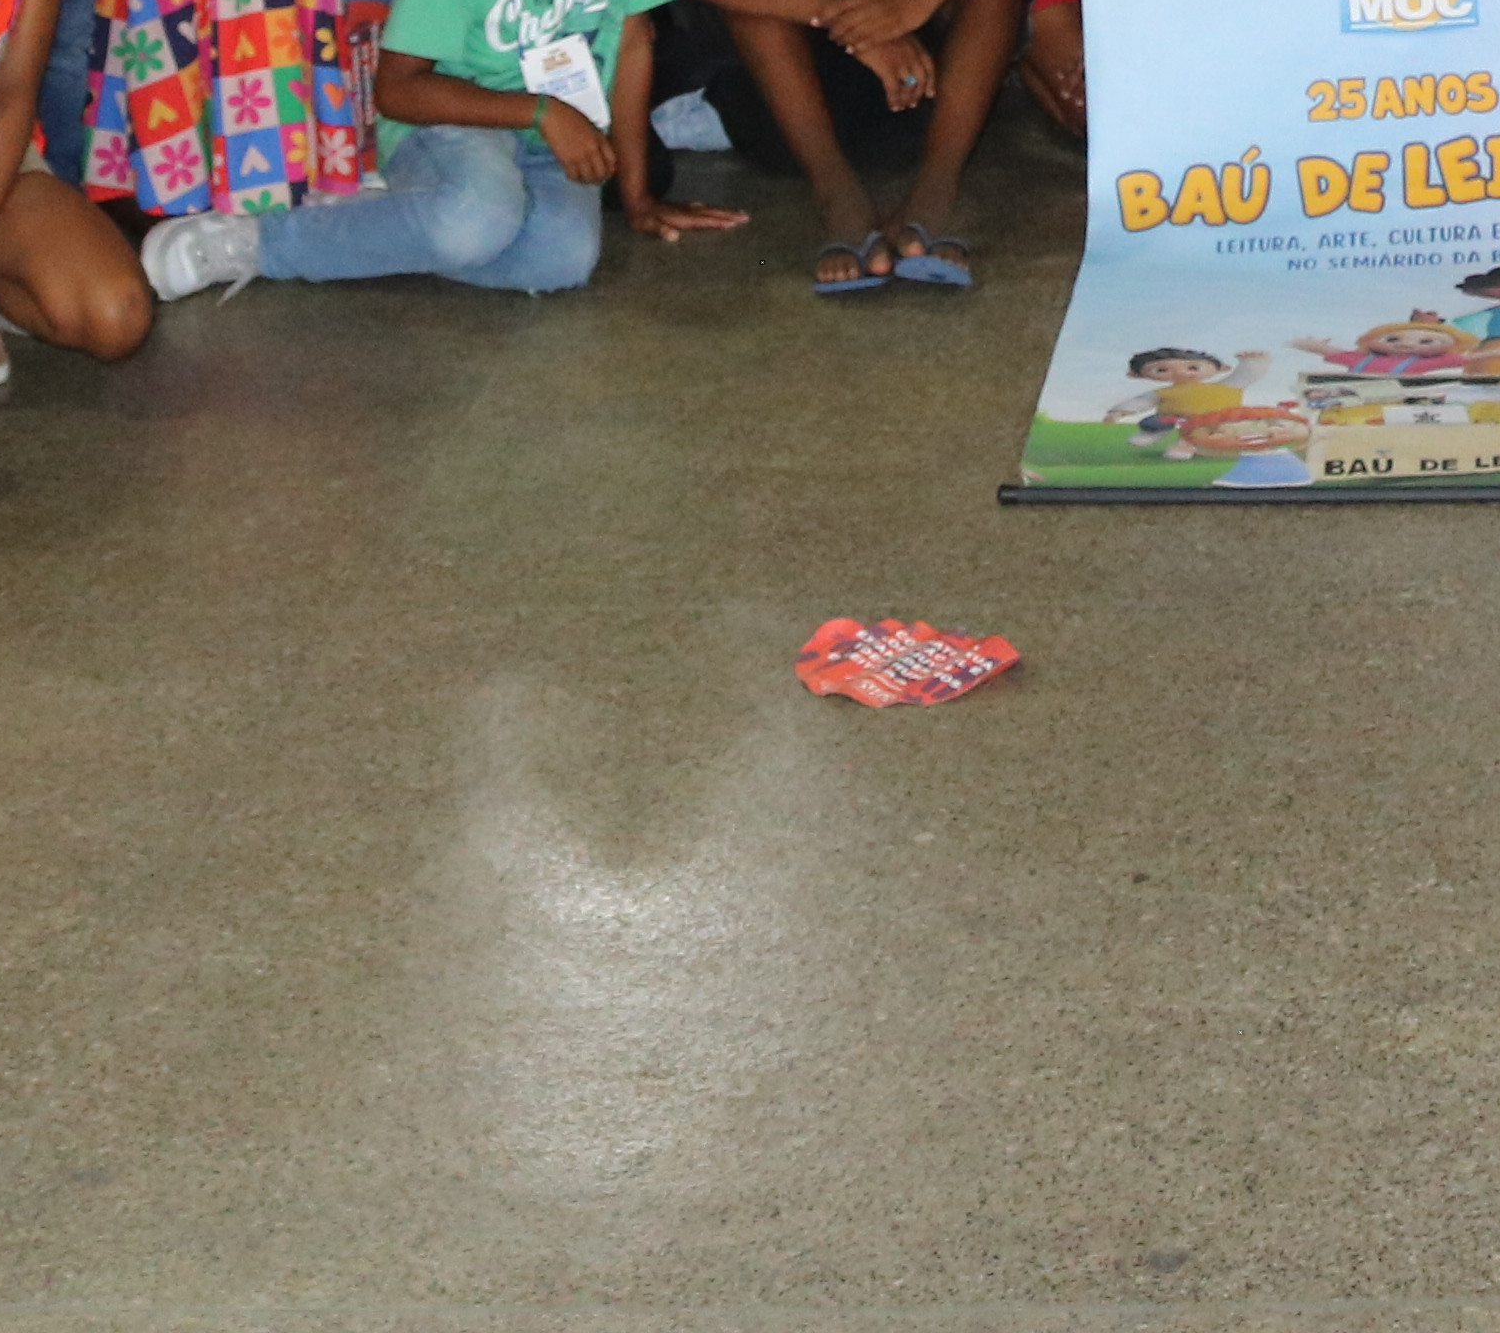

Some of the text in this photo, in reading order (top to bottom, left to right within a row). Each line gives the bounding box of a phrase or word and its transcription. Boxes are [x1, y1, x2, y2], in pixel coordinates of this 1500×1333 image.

[1306, 71, 1499, 121] 25 ANOS
[1116, 144, 1271, 232] BAÚ
[1296, 151, 1391, 217] DE
[1318, 232, 1377, 248] ARTE,
[1389, 224, 1482, 245] CULTURA
[1493, 223, 1500, 239] E
[1287, 258, 1316, 270] NO
[1328, 251, 1442, 270] SEMIÁRIDO
[1453, 250, 1481, 265] DA
[1420, 458, 1459, 472] DE
